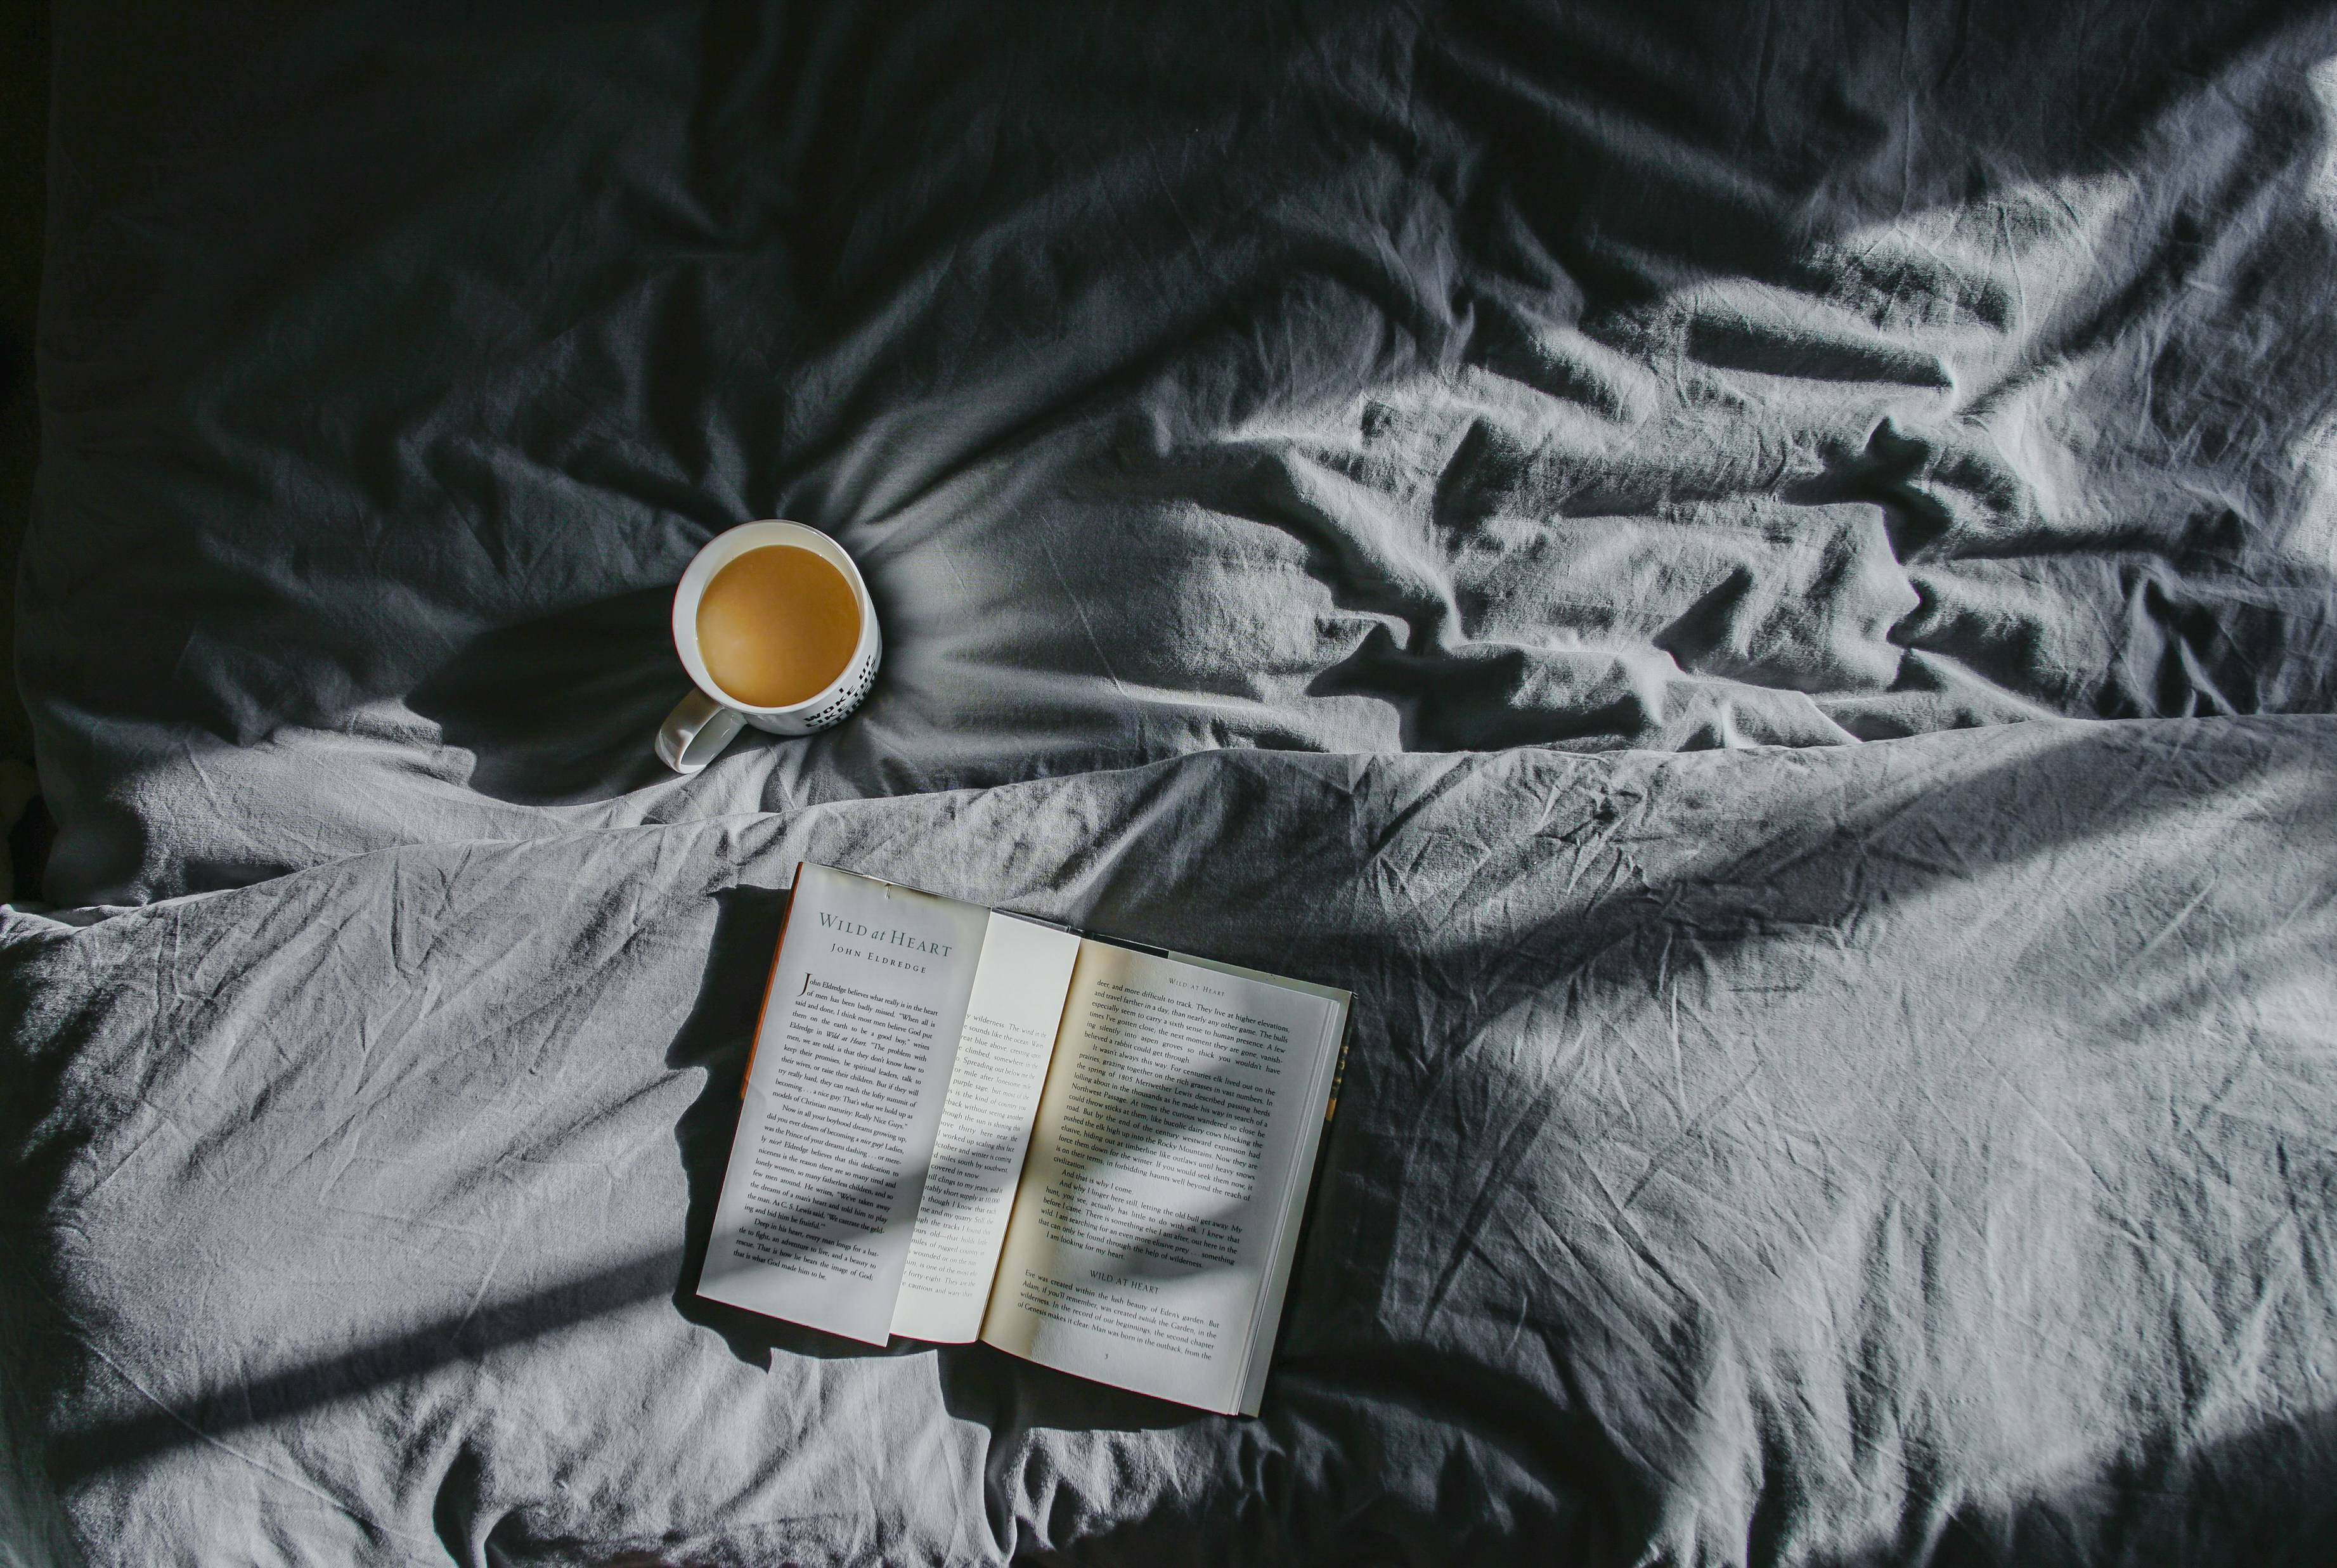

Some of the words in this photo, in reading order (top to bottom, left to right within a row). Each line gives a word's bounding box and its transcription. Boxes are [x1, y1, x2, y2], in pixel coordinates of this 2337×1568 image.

[803, 685, 856, 722] WOKE
[859, 654, 871, 680] UP
[805, 704, 847, 728] LIKE
[851, 657, 876, 697] THIS
[831, 943, 861, 957] JOHN
[868, 952, 926, 973] ELDREDGE
[872, 929, 886, 941] at
[890, 930, 952, 957] HEART
[798, 973, 821, 997] John
[822, 981, 847, 994] Eldredge
[847, 987, 869, 999] believes
[870, 994, 884, 1002] what
[884, 999, 900, 1008] really
[913, 1004, 923, 1013] the
[923, 1006, 938, 1016] heart
[1141, 990, 1165, 1002] difficult
[1196, 1003, 1213, 1014] They
[1214, 1008, 1226, 1017] live
[1235, 1013, 1257, 1024] higher
[789, 1021, 814, 1034] Eldredge
[826, 1030, 841, 1039] Wild
[887, 1048, 911, 1058] problem
[792, 1010, 807, 1020] them
[821, 1017, 831, 1025] the
[860, 1027, 868, 1035] be
[913, 1042, 929, 1051] writes
[781, 1055, 794, 1065] their
[835, 1070, 849, 1079] their
[876, 1080, 887, 1089] But
[894, 1085, 907, 1094] they
[1077, 1061, 1086, 1070] the
[1088, 1066, 1106, 1077] spring
[1118, 1073, 1134, 1082] 1805
[1135, 1077, 1172, 1092] Meriwether
[1173, 1087, 1193, 1098] Lewis
[1194, 1092, 1226, 1106] described
[1227, 1103, 1251, 1113] passing
[1253, 1106, 1271, 1117] herds
[772, 1091, 793, 1100] models
[801, 1097, 826, 1109] Christian
[855, 1111, 872, 1122] Really
[872, 1115, 887, 1125] Nice
[1071, 1082, 1102, 1097] Northwest
[1130, 1098, 1139, 1106] At
[1141, 1101, 1158, 1111] times
[1160, 1106, 1170, 1115] the
[1172, 1111, 1195, 1121] curious
[1197, 1117, 1228, 1129] wandered
[1239, 1125, 1256, 1136] close
[1257, 1129, 1266, 1138] he
[943, 1132, 966, 1143] worked
[976, 1141, 995, 1151] scaling
[1083, 1107, 1093, 1117] But
[1095, 1111, 1104, 1120] by
[1106, 1114, 1117, 1123] the
[1142, 1124, 1153, 1132] the
[1155, 1129, 1180, 1140] century
[1182, 1136, 1212, 1147] westward
[1214, 1144, 1246, 1156] expansion
[1248, 1150, 1261, 1160] had
[931, 1164, 956, 1174] covered
[940, 1155, 956, 1163] miles
[957, 1159, 974, 1167] south
[975, 1161, 983, 1170] by
[971, 1151, 990, 1159] winter
[755, 1157, 774, 1169] lonely
[805, 1172, 822, 1182] many
[822, 1176, 848, 1188] fatherless
[938, 1176, 955, 1186] clings
[1061, 1169, 1075, 1179] And
[1075, 1172, 1088, 1182] that
[1096, 1179, 1109, 1189] why
[753, 1169, 763, 1177] few
[804, 1182, 813, 1191] He
[858, 1198, 874, 1207] taken
[876, 1203, 891, 1213] away
[1060, 1235, 1084, 1250] looking
[1085, 1242, 1094, 1251] for
[1091, 1270, 1113, 1283] WILD
[1116, 1278, 1128, 1286] AT
[1131, 1281, 1160, 1294] HEART
